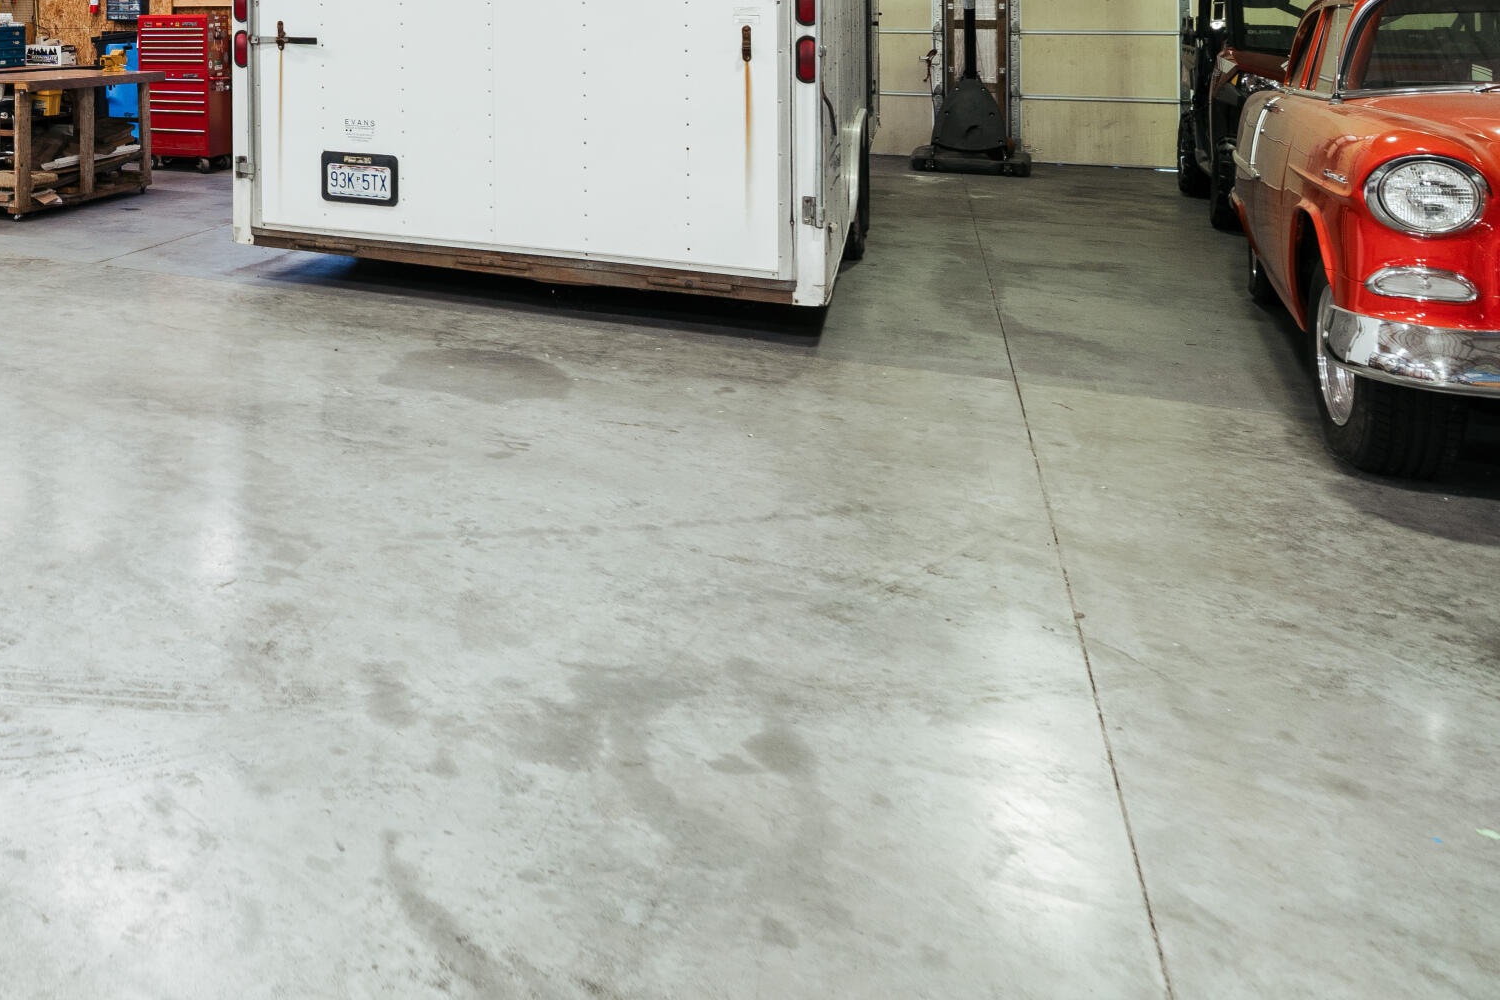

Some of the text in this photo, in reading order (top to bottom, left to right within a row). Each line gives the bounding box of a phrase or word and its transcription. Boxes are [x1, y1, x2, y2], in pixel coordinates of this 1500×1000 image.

[344, 119, 376, 127] EVANS
[330, 171, 355, 190] 93K
[362, 174, 388, 193] 5TX
